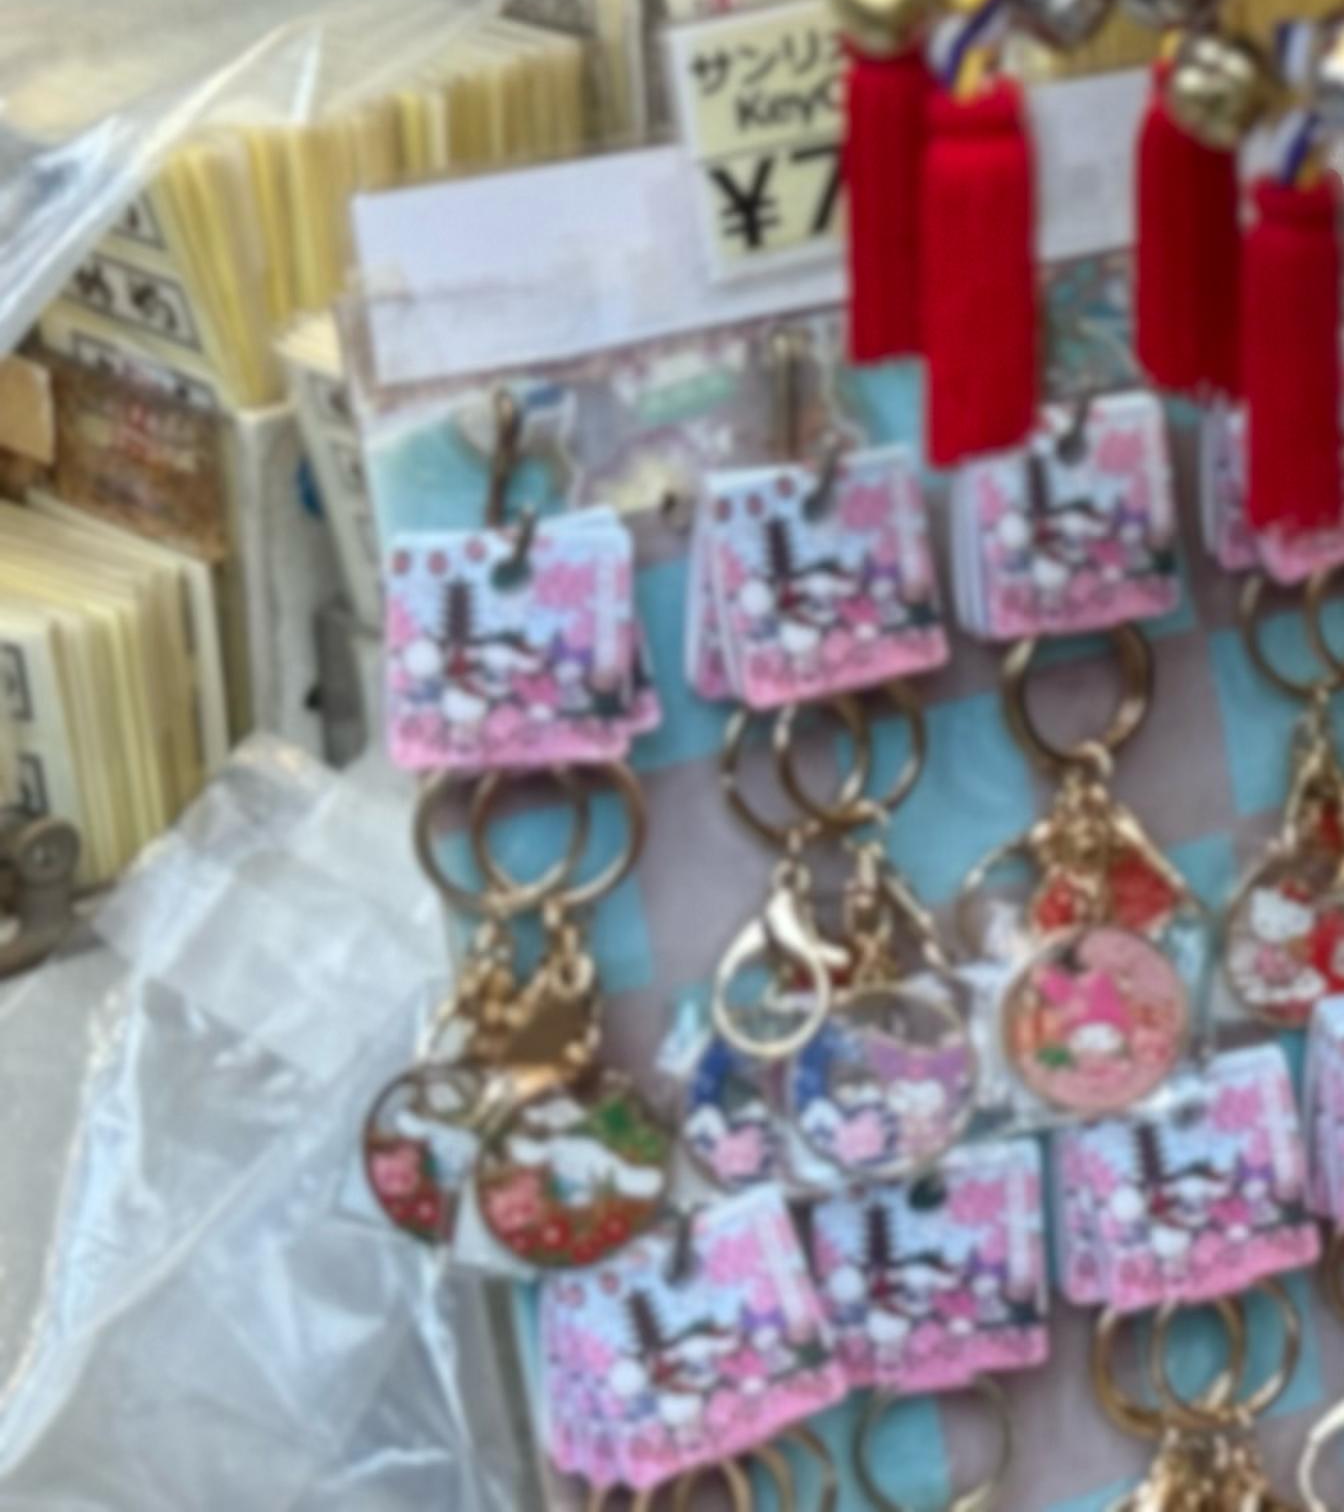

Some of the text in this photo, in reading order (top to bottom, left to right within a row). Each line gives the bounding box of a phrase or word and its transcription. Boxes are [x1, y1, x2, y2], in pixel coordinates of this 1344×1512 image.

[690, 29, 839, 97] サンリ
[734, 78, 839, 132] Key
[708, 144, 843, 251] ¥7
